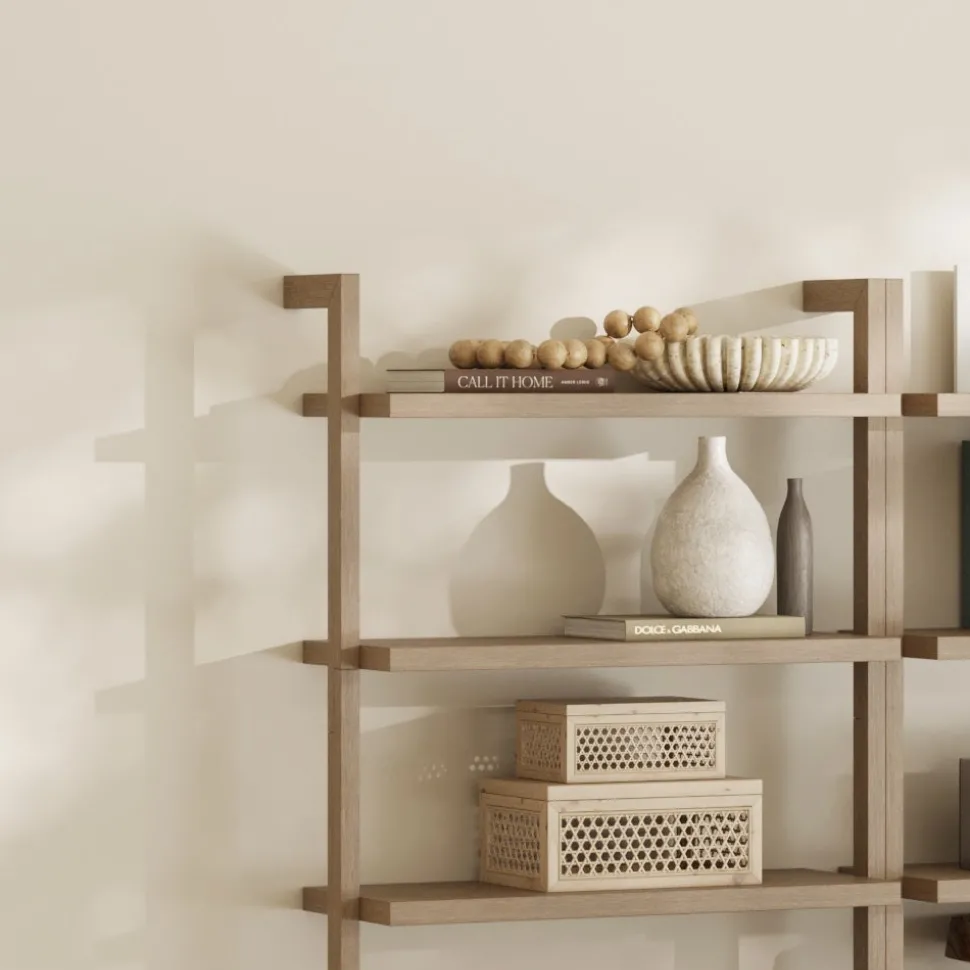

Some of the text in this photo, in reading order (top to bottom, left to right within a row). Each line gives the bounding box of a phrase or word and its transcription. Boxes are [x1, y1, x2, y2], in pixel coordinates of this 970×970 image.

[457, 375, 553, 389] CALL IT HOME
[634, 625, 666, 635] DOLCE
[672, 624, 722, 634] GABBANA
